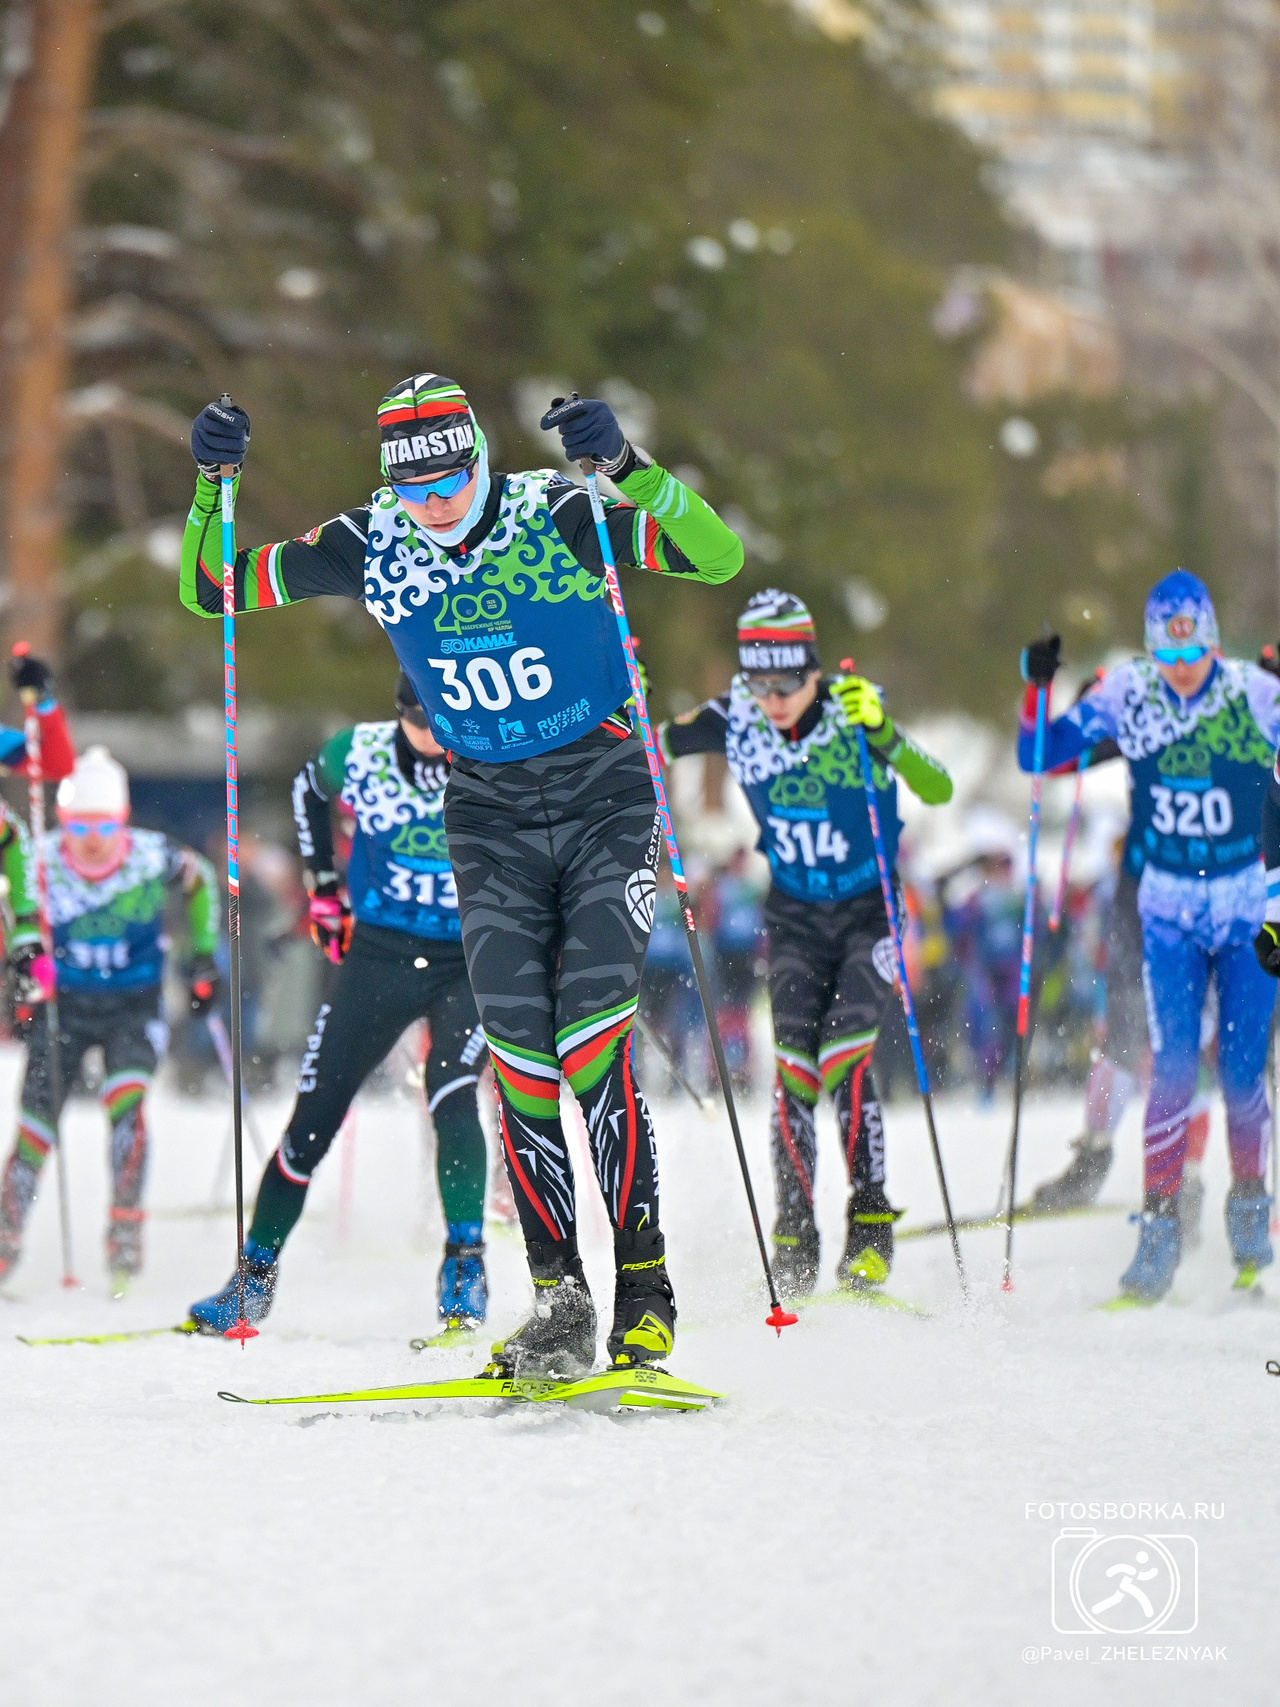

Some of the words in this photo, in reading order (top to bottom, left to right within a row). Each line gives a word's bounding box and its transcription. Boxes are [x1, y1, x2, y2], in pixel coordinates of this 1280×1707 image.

[547, 400, 584, 420] NORDSKI
[427, 646, 553, 711] 306
[1150, 785, 1233, 837] 320
[767, 816, 850, 868] 314
[532, 1277, 558, 1287] CHER
